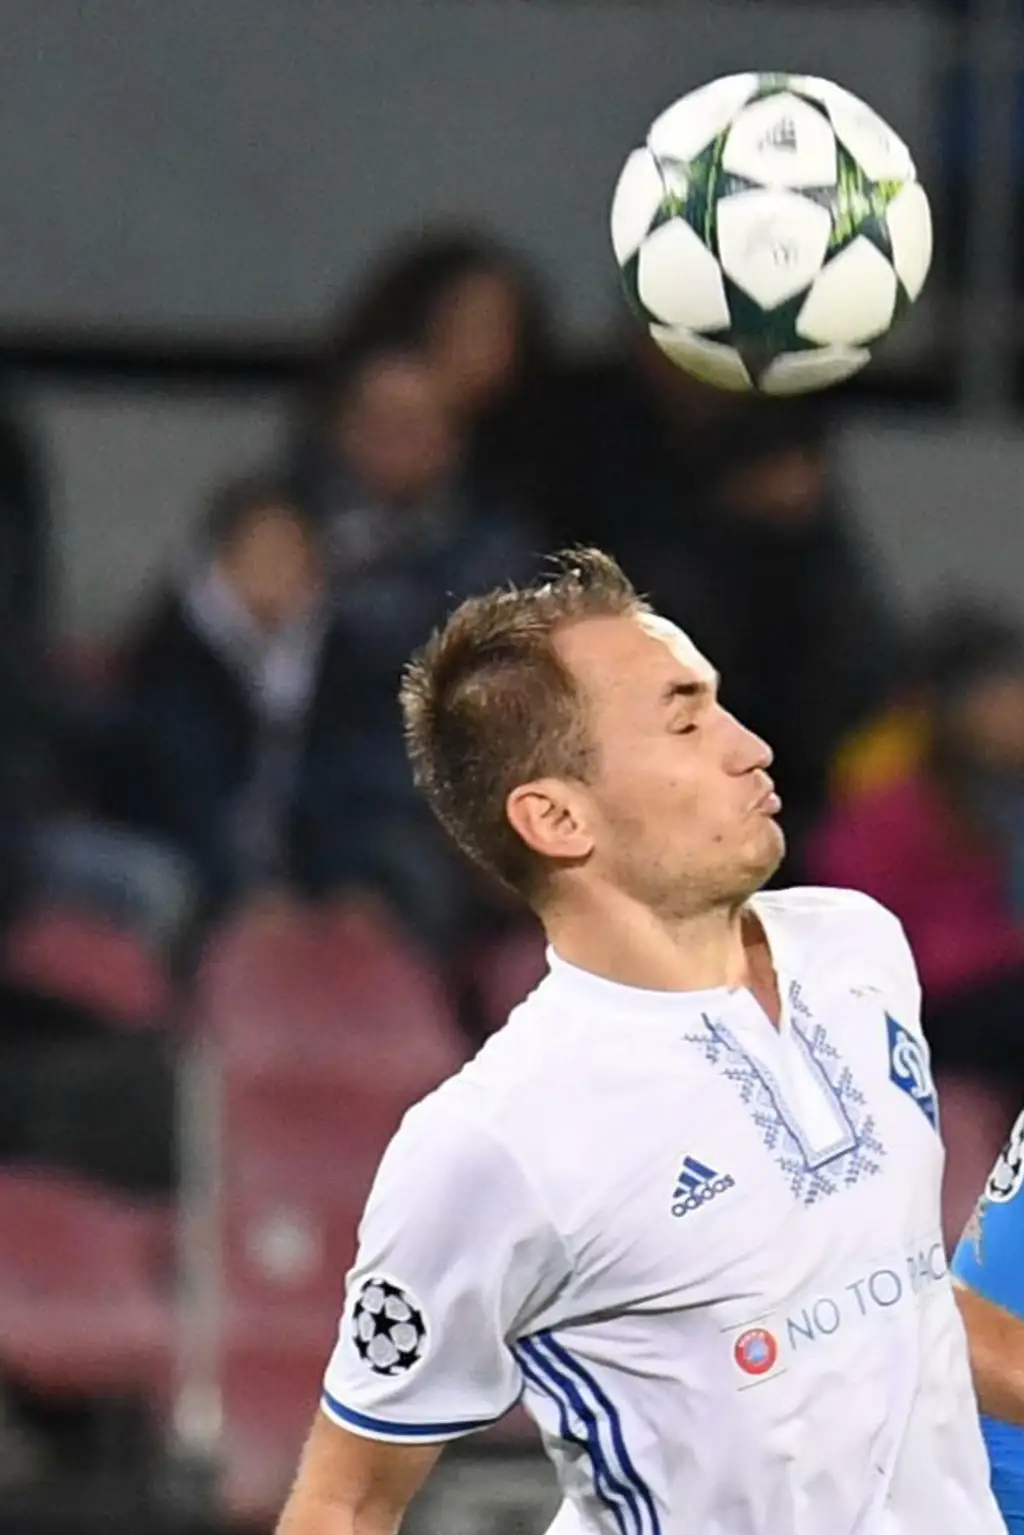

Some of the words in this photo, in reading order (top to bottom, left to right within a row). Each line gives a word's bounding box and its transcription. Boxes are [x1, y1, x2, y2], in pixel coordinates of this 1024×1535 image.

[671, 1174, 735, 1217] adidas
[786, 1297, 840, 1350] NO
[845, 1269, 903, 1317] TO
